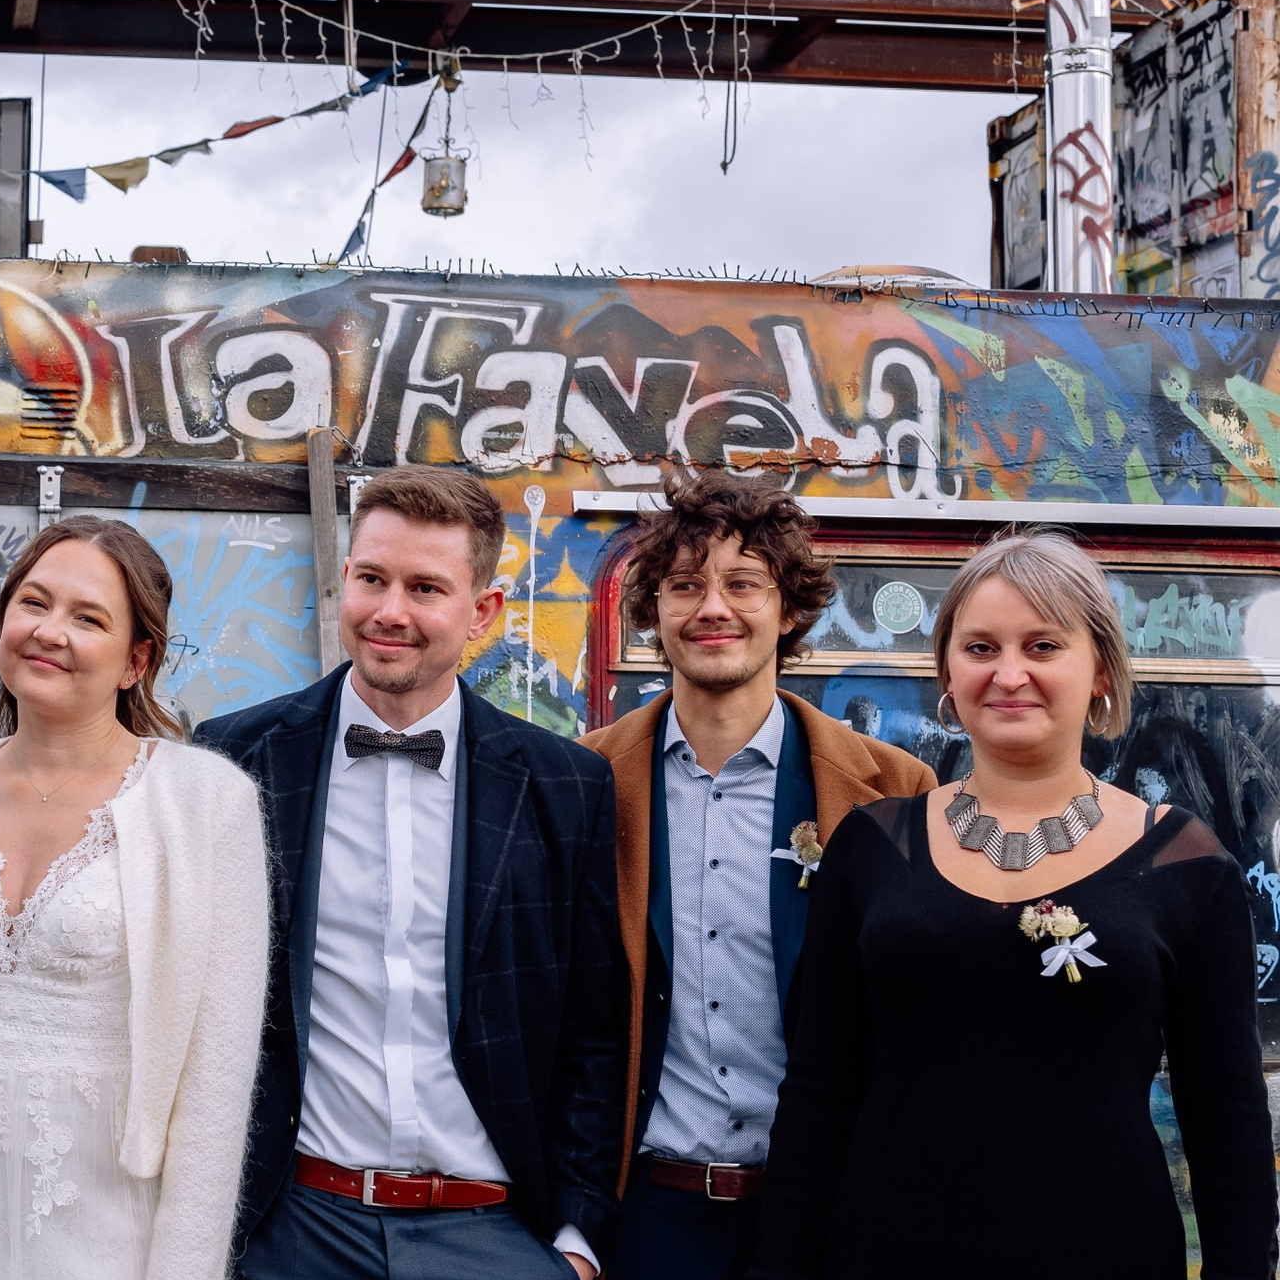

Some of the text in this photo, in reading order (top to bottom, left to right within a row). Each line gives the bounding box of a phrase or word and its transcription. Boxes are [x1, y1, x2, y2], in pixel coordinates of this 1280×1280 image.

[877, 585, 920, 616] ANTIFA FOR FUTURE
